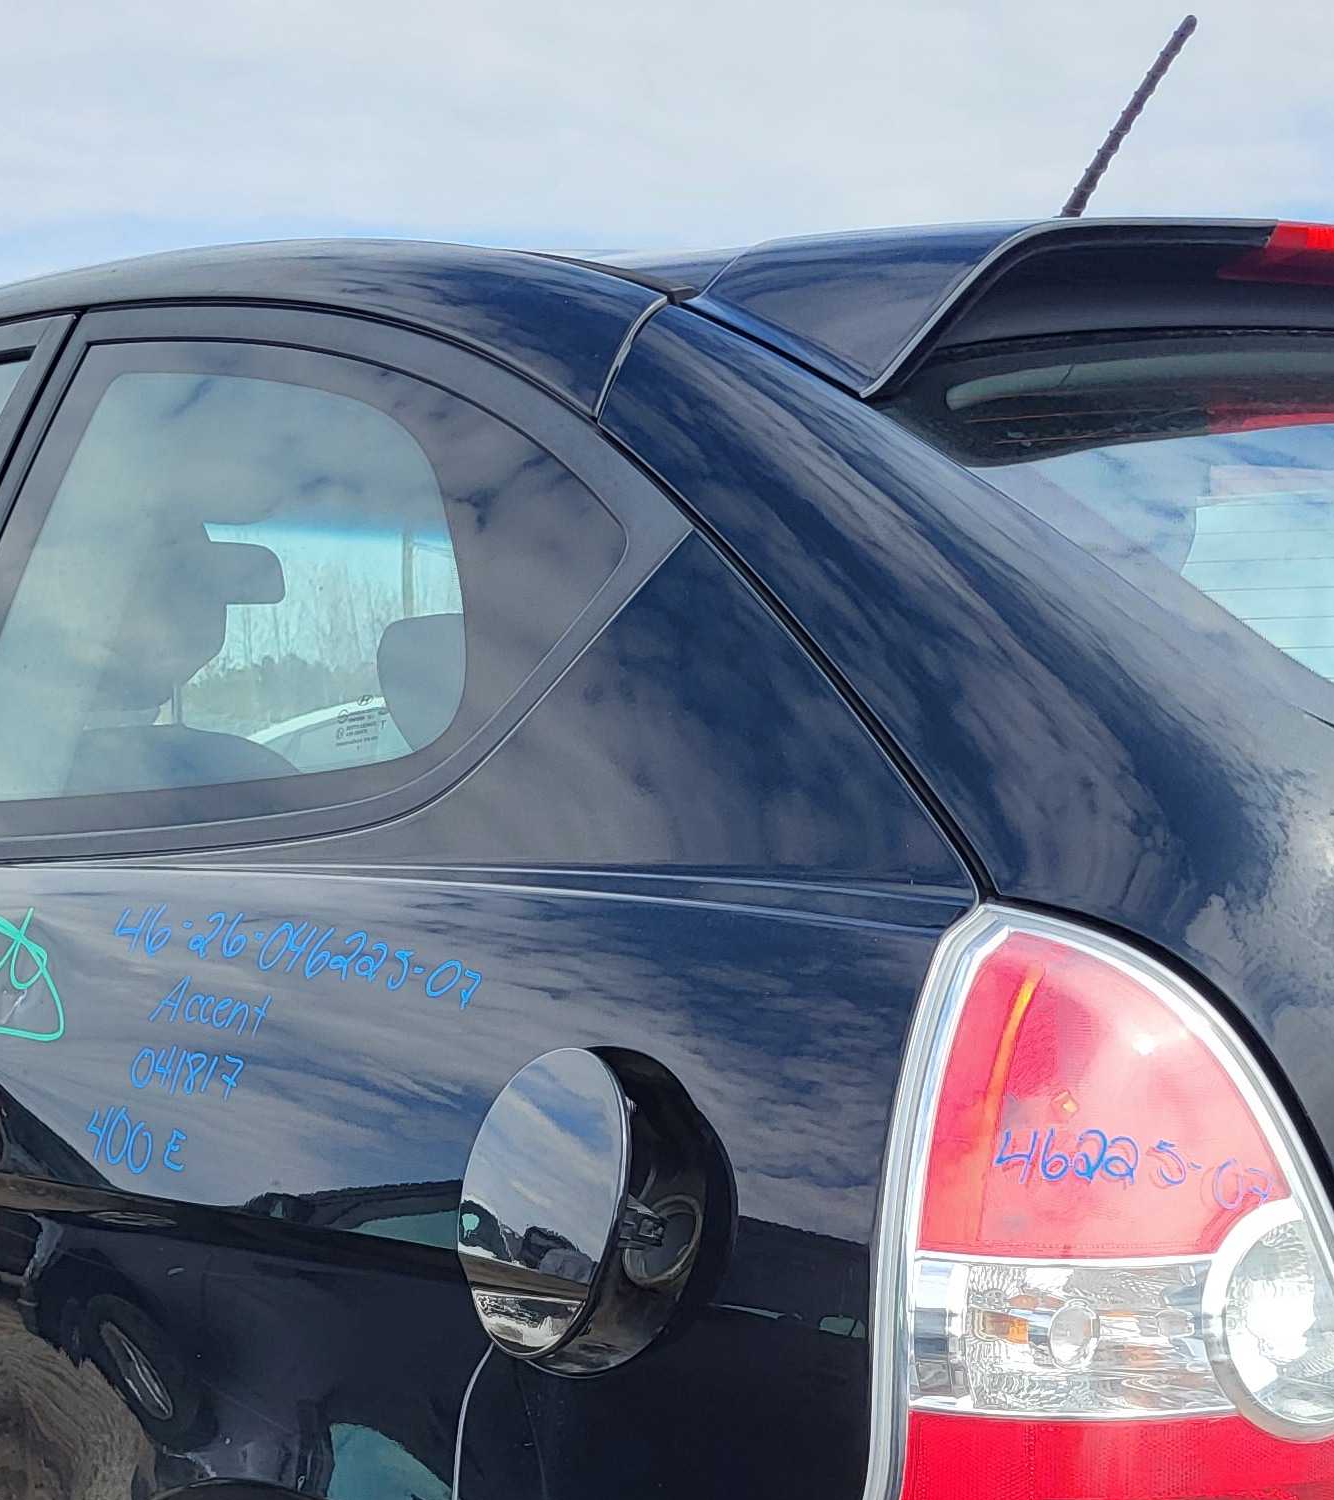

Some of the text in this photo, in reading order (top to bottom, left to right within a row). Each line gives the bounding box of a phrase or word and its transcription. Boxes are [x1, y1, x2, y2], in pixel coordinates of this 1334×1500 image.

[148, 975, 272, 1039] Accent
[86, 1105, 153, 1174] 400
[994, 1127, 1276, 1211] 46225-07
